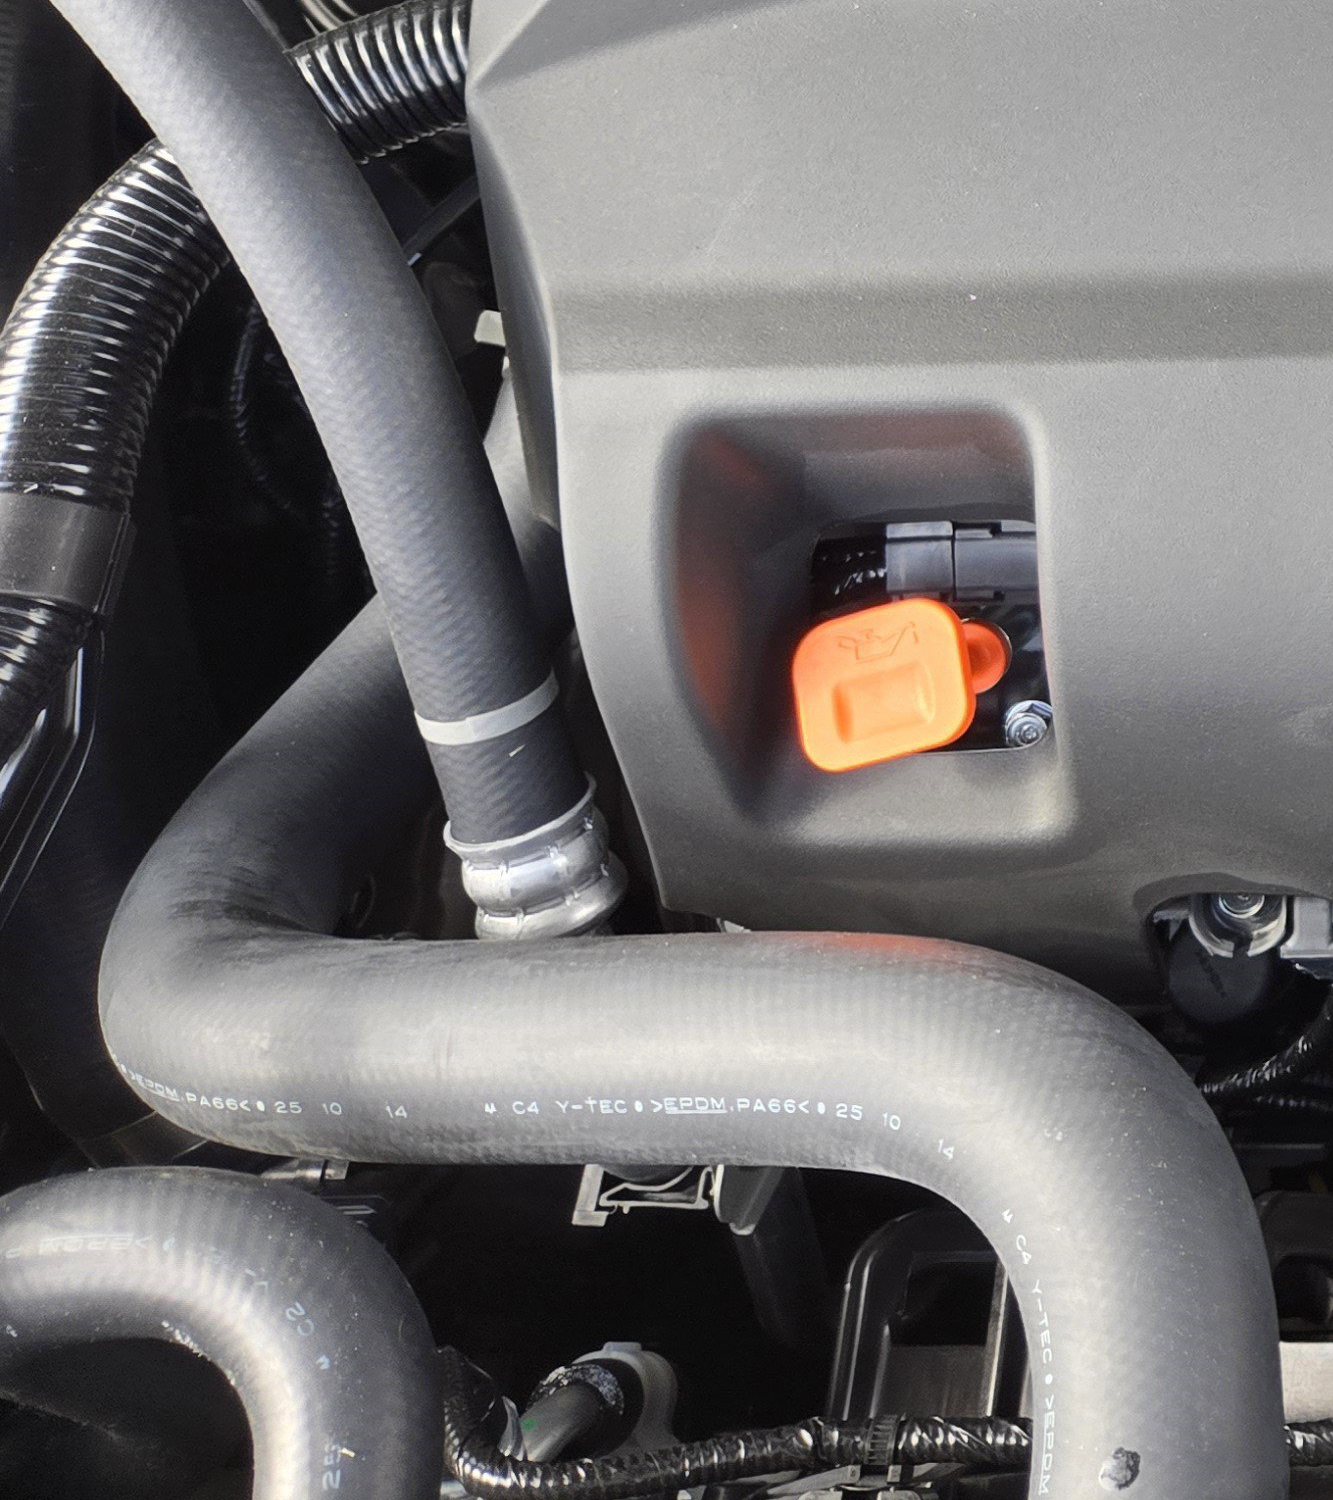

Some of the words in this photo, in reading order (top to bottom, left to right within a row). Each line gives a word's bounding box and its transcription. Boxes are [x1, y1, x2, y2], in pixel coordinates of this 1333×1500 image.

[274, 1100, 303, 1115] 25
[321, 1101, 343, 1116] 10
[384, 1103, 408, 1120] 14
[512, 1100, 541, 1116] C4
[556, 1097, 629, 1115] Y-TEC
[835, 1101, 864, 1122] 25
[880, 1111, 902, 1132] 10
[935, 1137, 956, 1161] 14
[1031, 1277, 1054, 1365] Y-TEC
